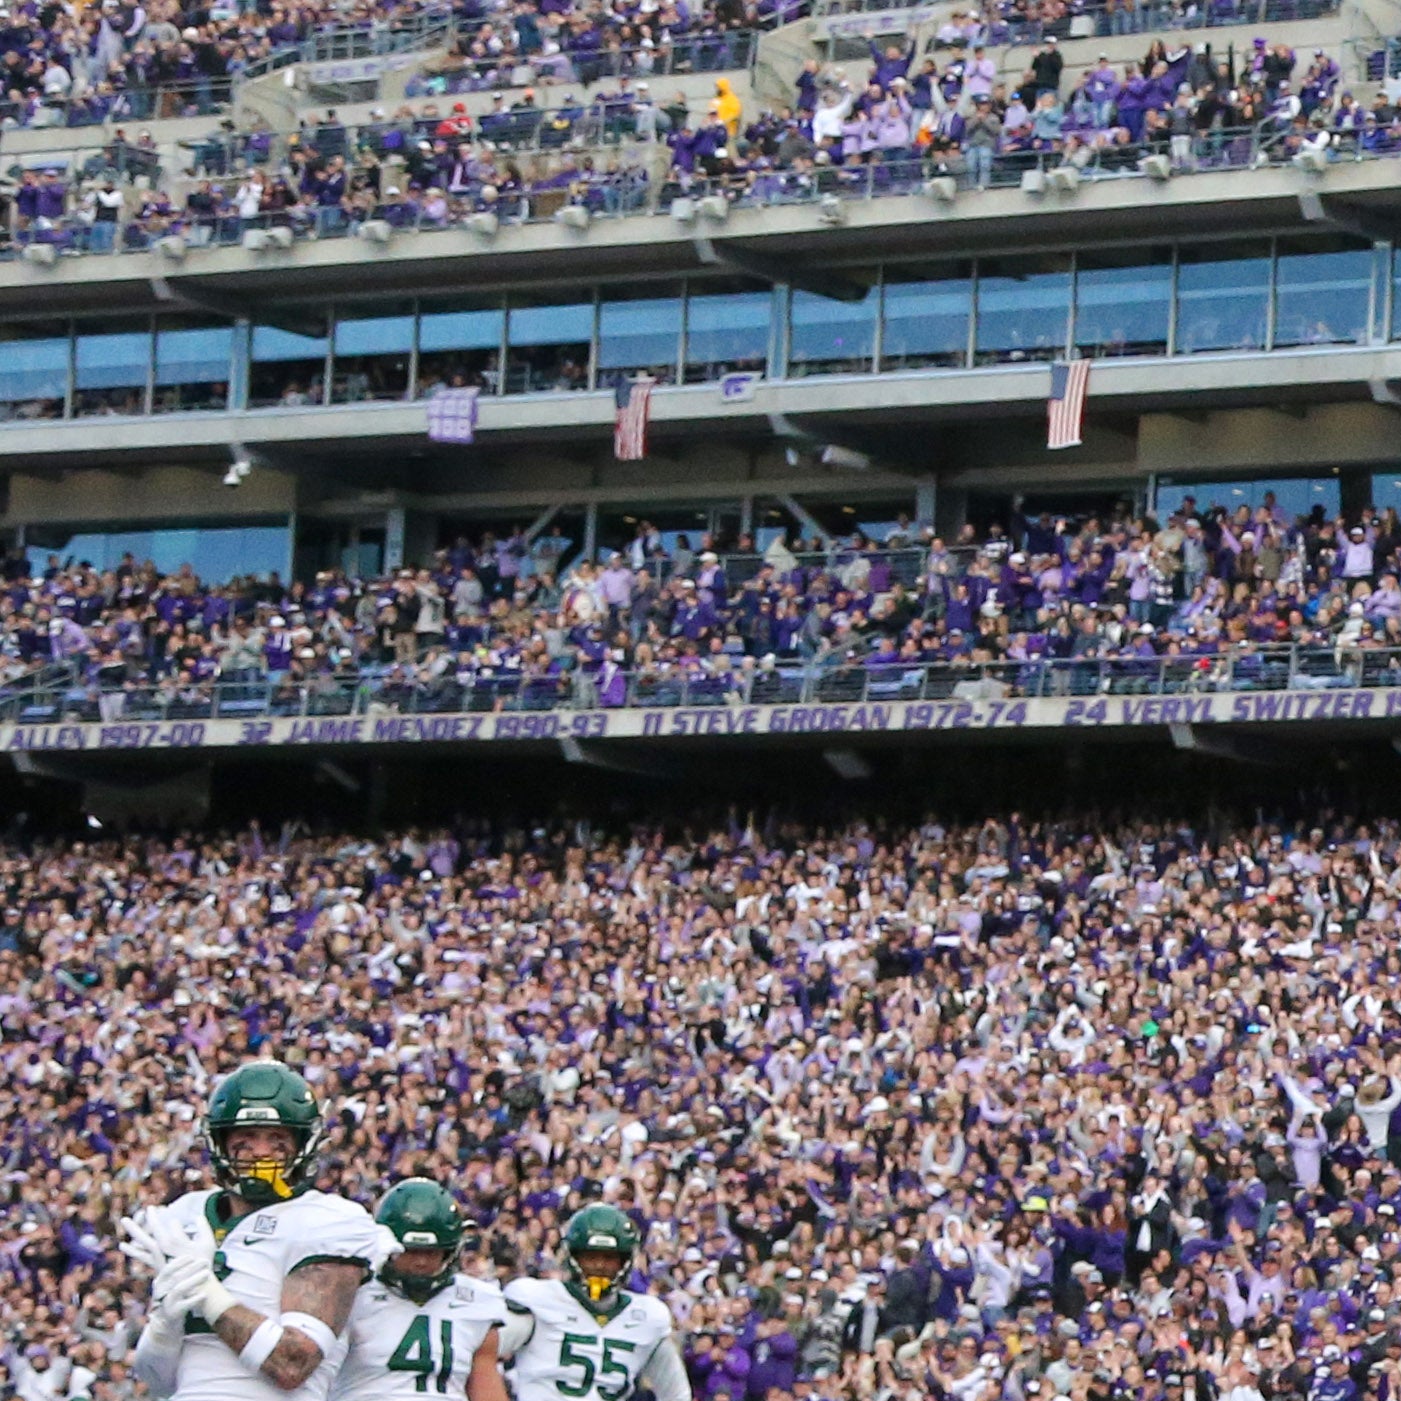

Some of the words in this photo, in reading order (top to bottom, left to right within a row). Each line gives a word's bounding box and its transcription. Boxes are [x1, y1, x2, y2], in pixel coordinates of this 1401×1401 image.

[671, 708, 761, 735] STEVE
[769, 701, 892, 733] GROGAN
[902, 700, 1029, 730] 1972-74
[1065, 699, 1108, 725] 24
[1121, 695, 1218, 724] VERYL
[1232, 690, 1376, 721] SWITZER
[7, 724, 88, 751] ALLEN
[100, 721, 207, 749] 1997-00
[287, 718, 364, 745] JAIME
[372, 714, 487, 743] MENDEZ
[495, 713, 609, 740] 1990-93
[387, 1314, 454, 1393] 41
